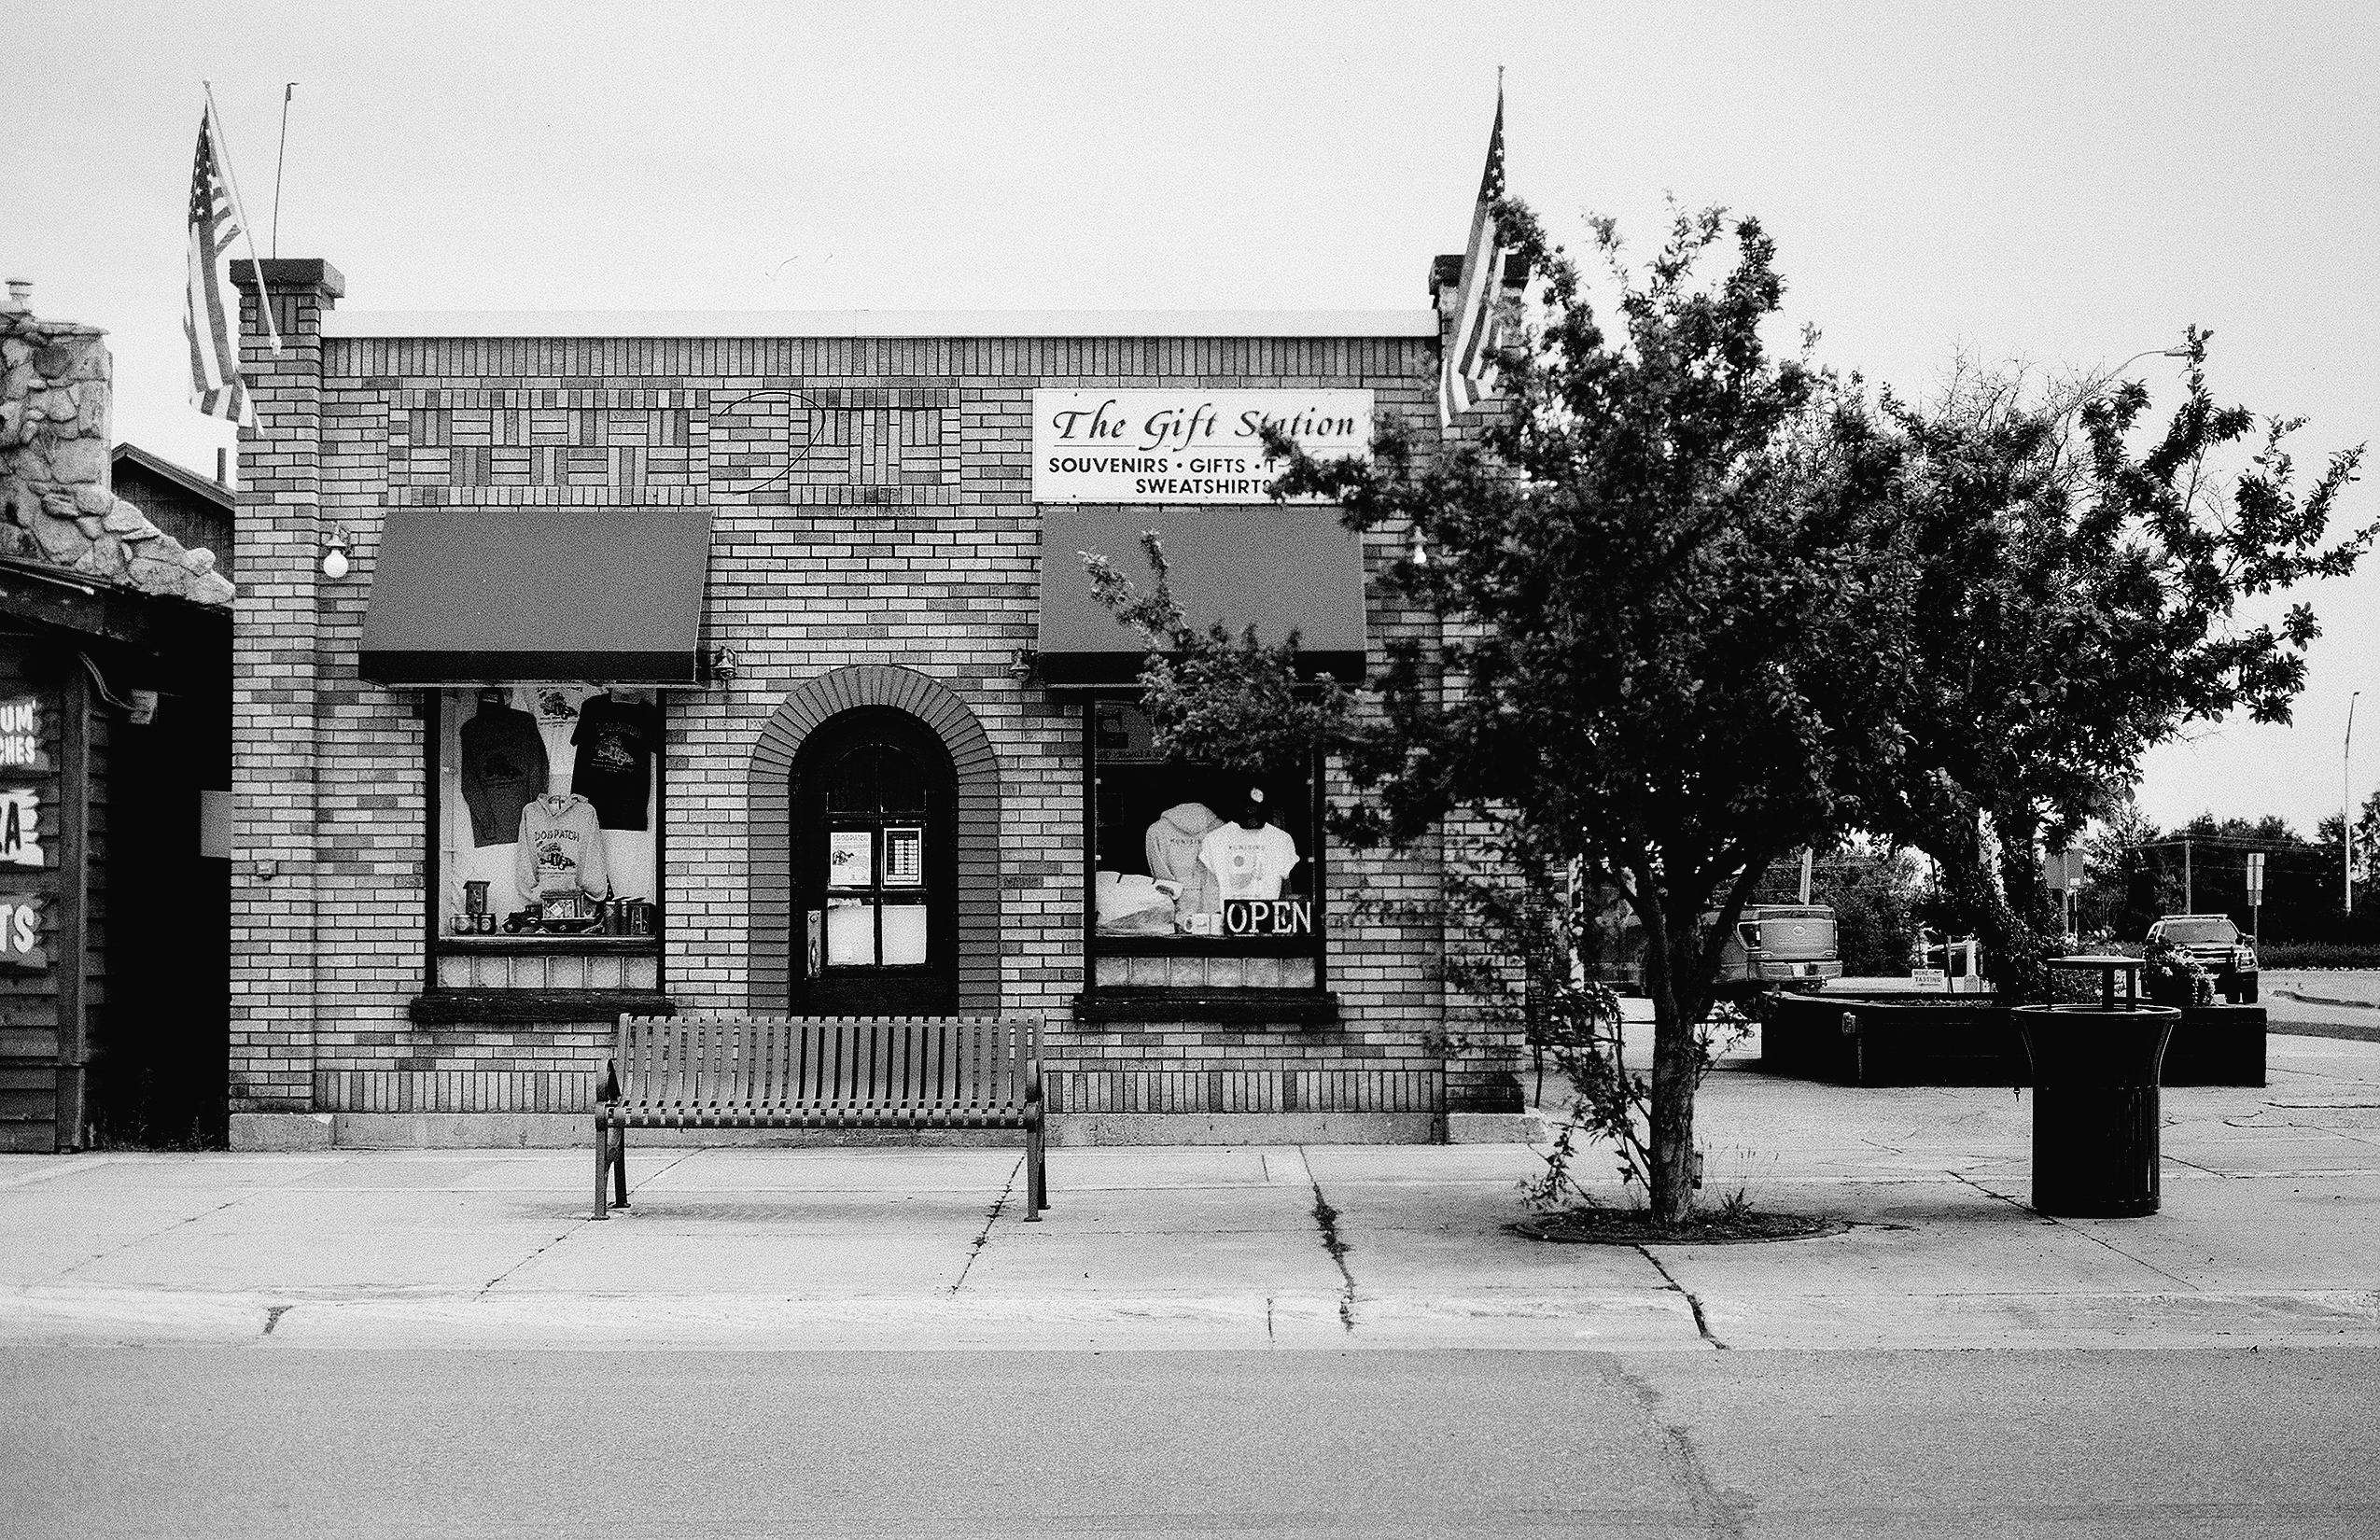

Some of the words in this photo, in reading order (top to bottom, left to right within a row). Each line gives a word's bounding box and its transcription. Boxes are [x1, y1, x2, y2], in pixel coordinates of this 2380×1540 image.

[1052, 399, 1127, 439] The
[1138, 402, 1218, 453] Gift
[1048, 457, 1169, 473] SOUVENIRS
[1189, 457, 1246, 473] GIFTS
[0, 801, 21, 856] A
[1226, 901, 1311, 933] OPEN
